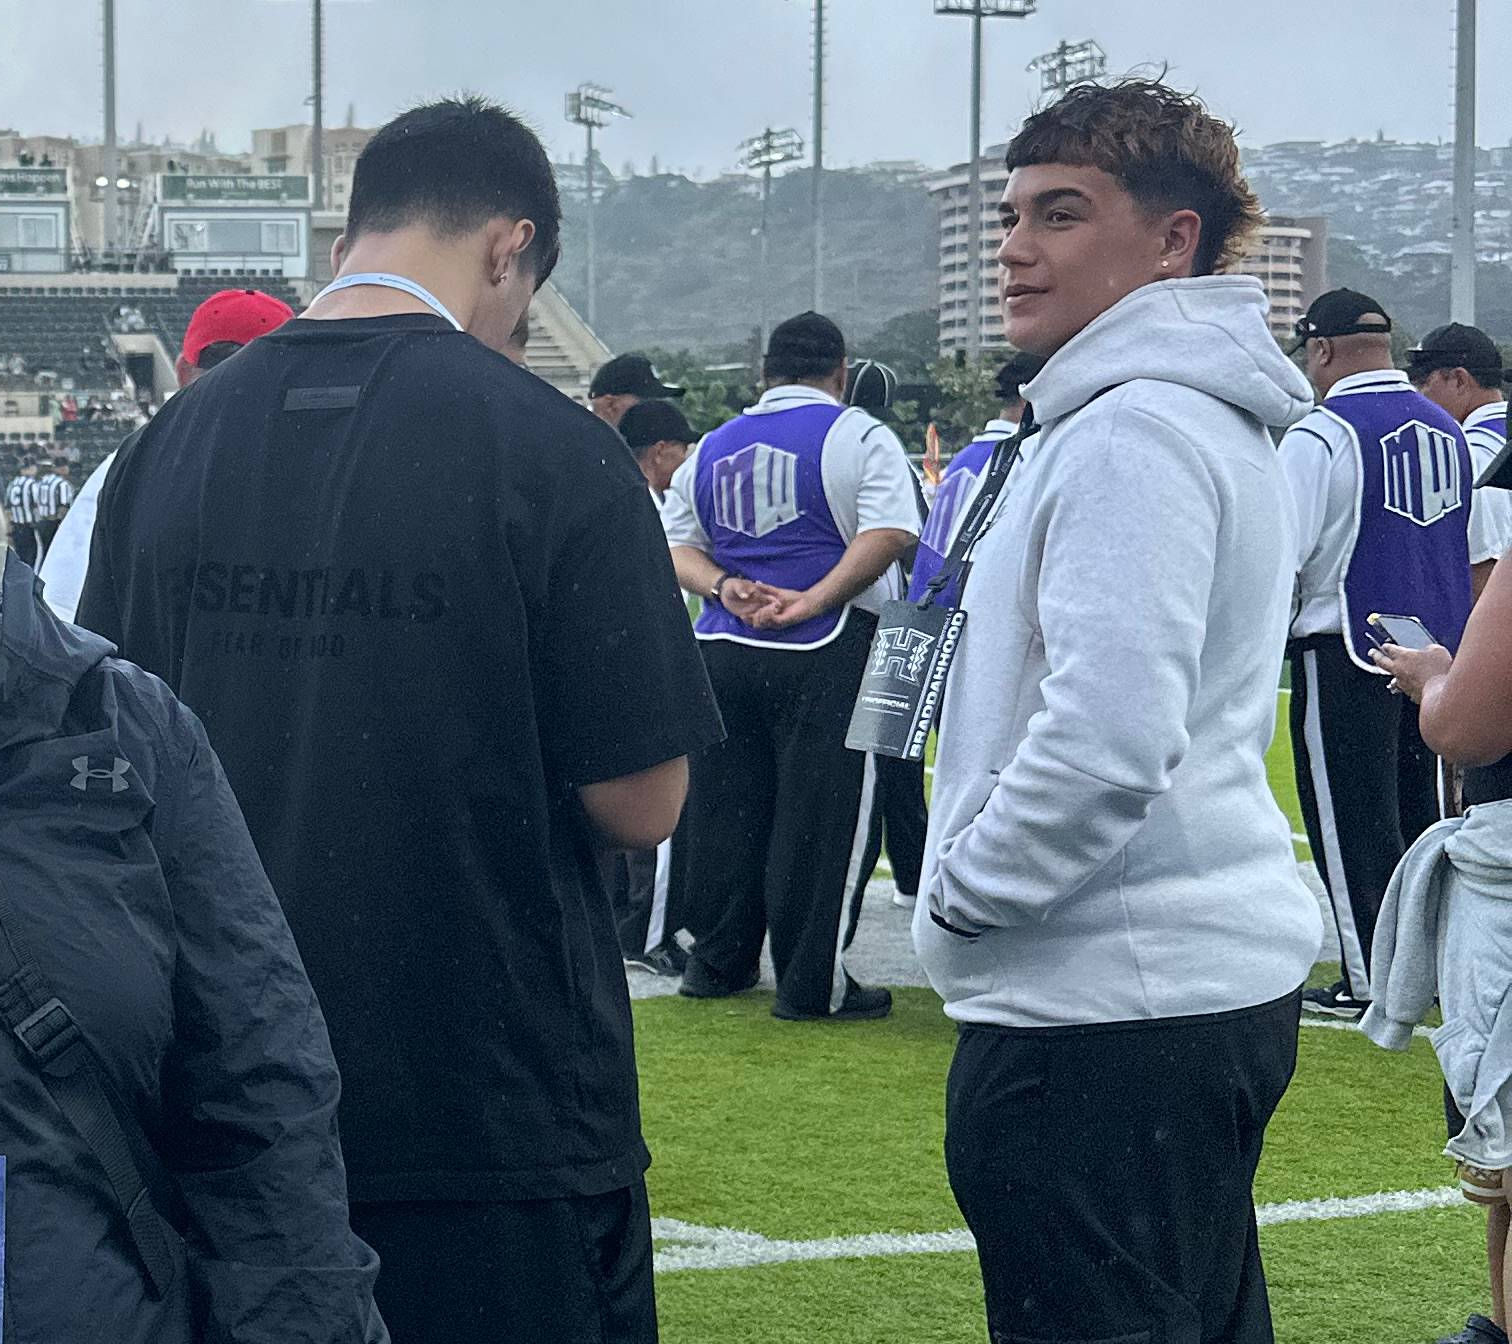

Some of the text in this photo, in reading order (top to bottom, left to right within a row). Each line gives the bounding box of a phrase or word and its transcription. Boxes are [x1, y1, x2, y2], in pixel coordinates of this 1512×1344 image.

[17, 171, 61, 185] Happen
[186, 178, 206, 189] Run
[208, 178, 234, 189] With
[237, 178, 256, 189] The
[166, 561, 448, 624] SENTIALS
[909, 610, 966, 757] BRADDAHHOOD
